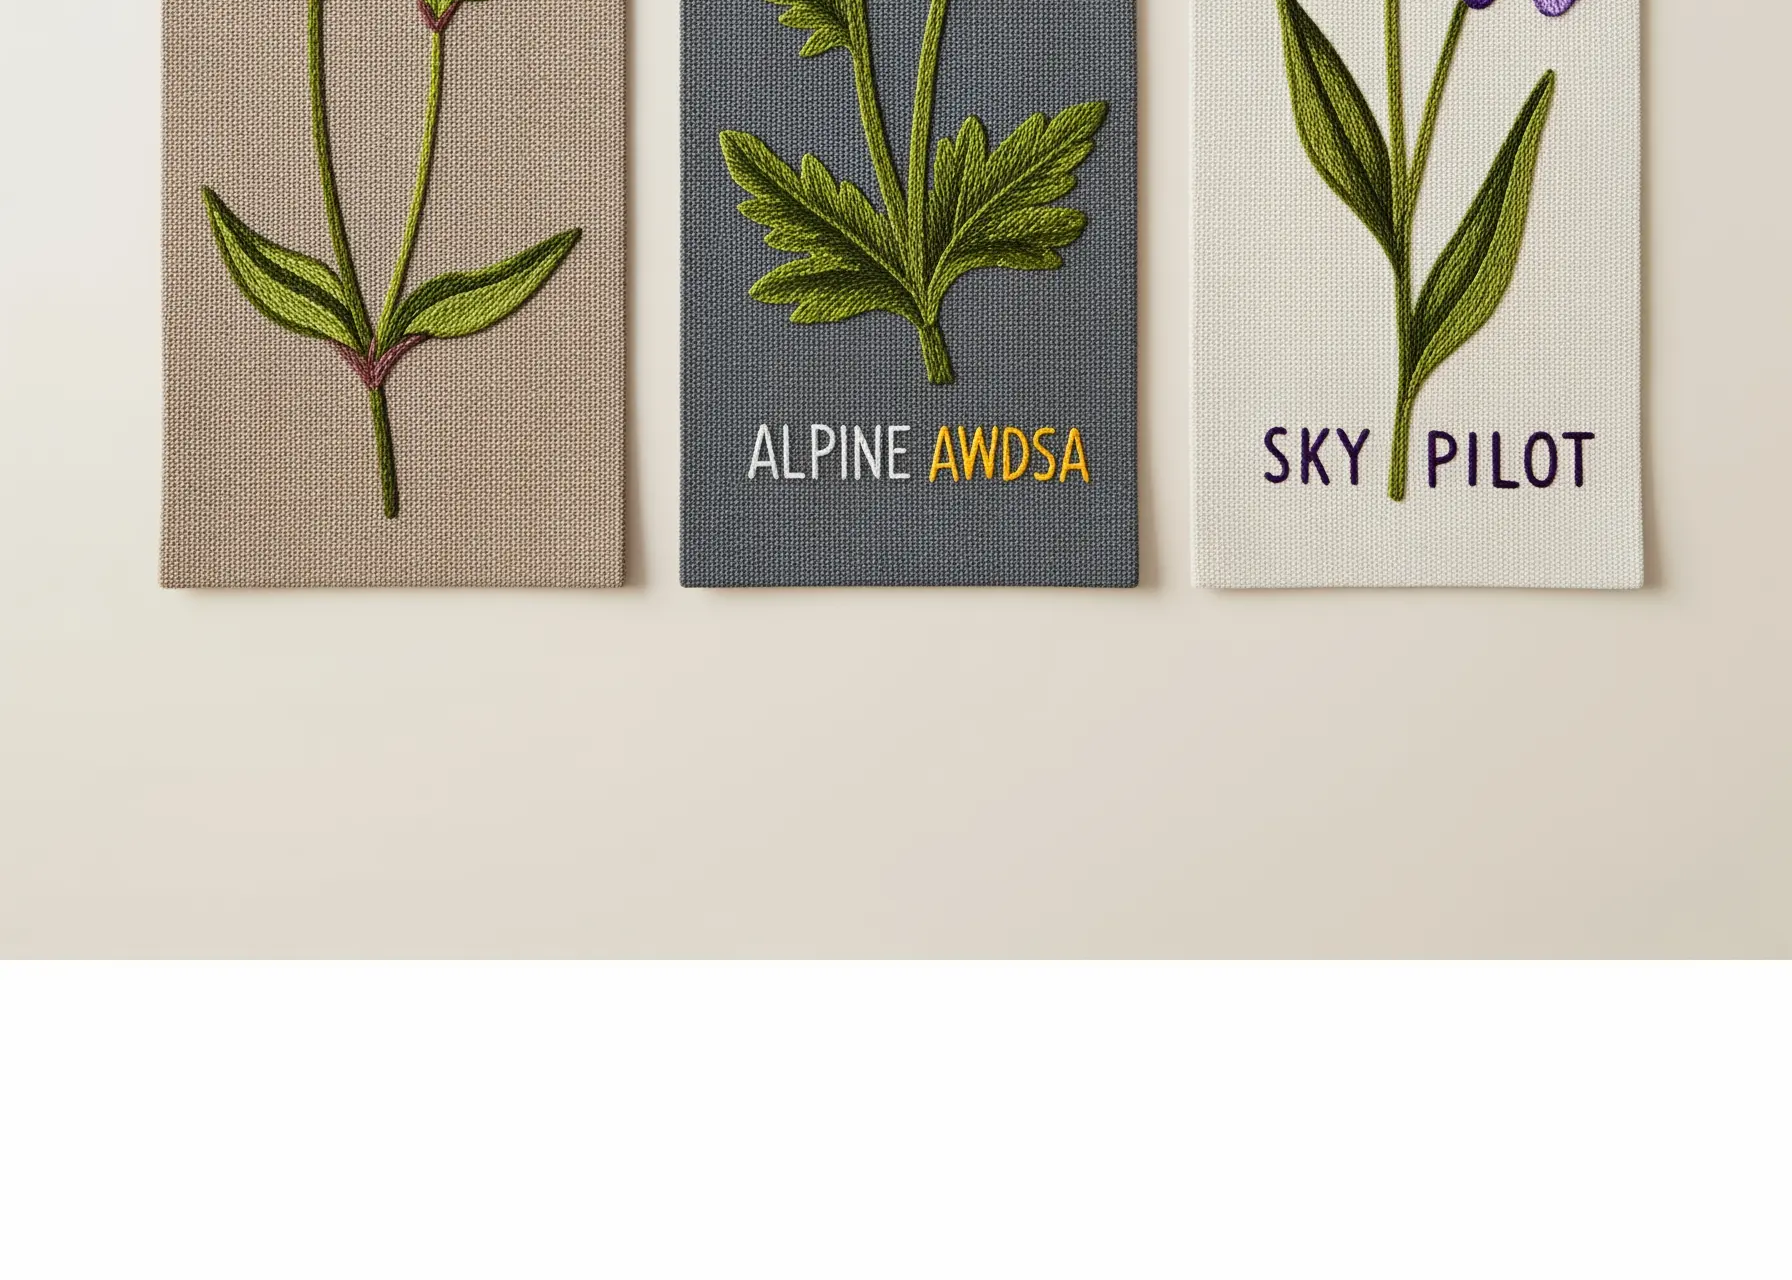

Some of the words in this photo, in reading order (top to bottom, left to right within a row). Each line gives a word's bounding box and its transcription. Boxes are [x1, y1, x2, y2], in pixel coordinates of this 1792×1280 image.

[748, 423, 910, 480] ALPINE
[929, 425, 1089, 482] AWDSA
[1264, 426, 1370, 485] SKY
[1428, 430, 1595, 488] PILOT
